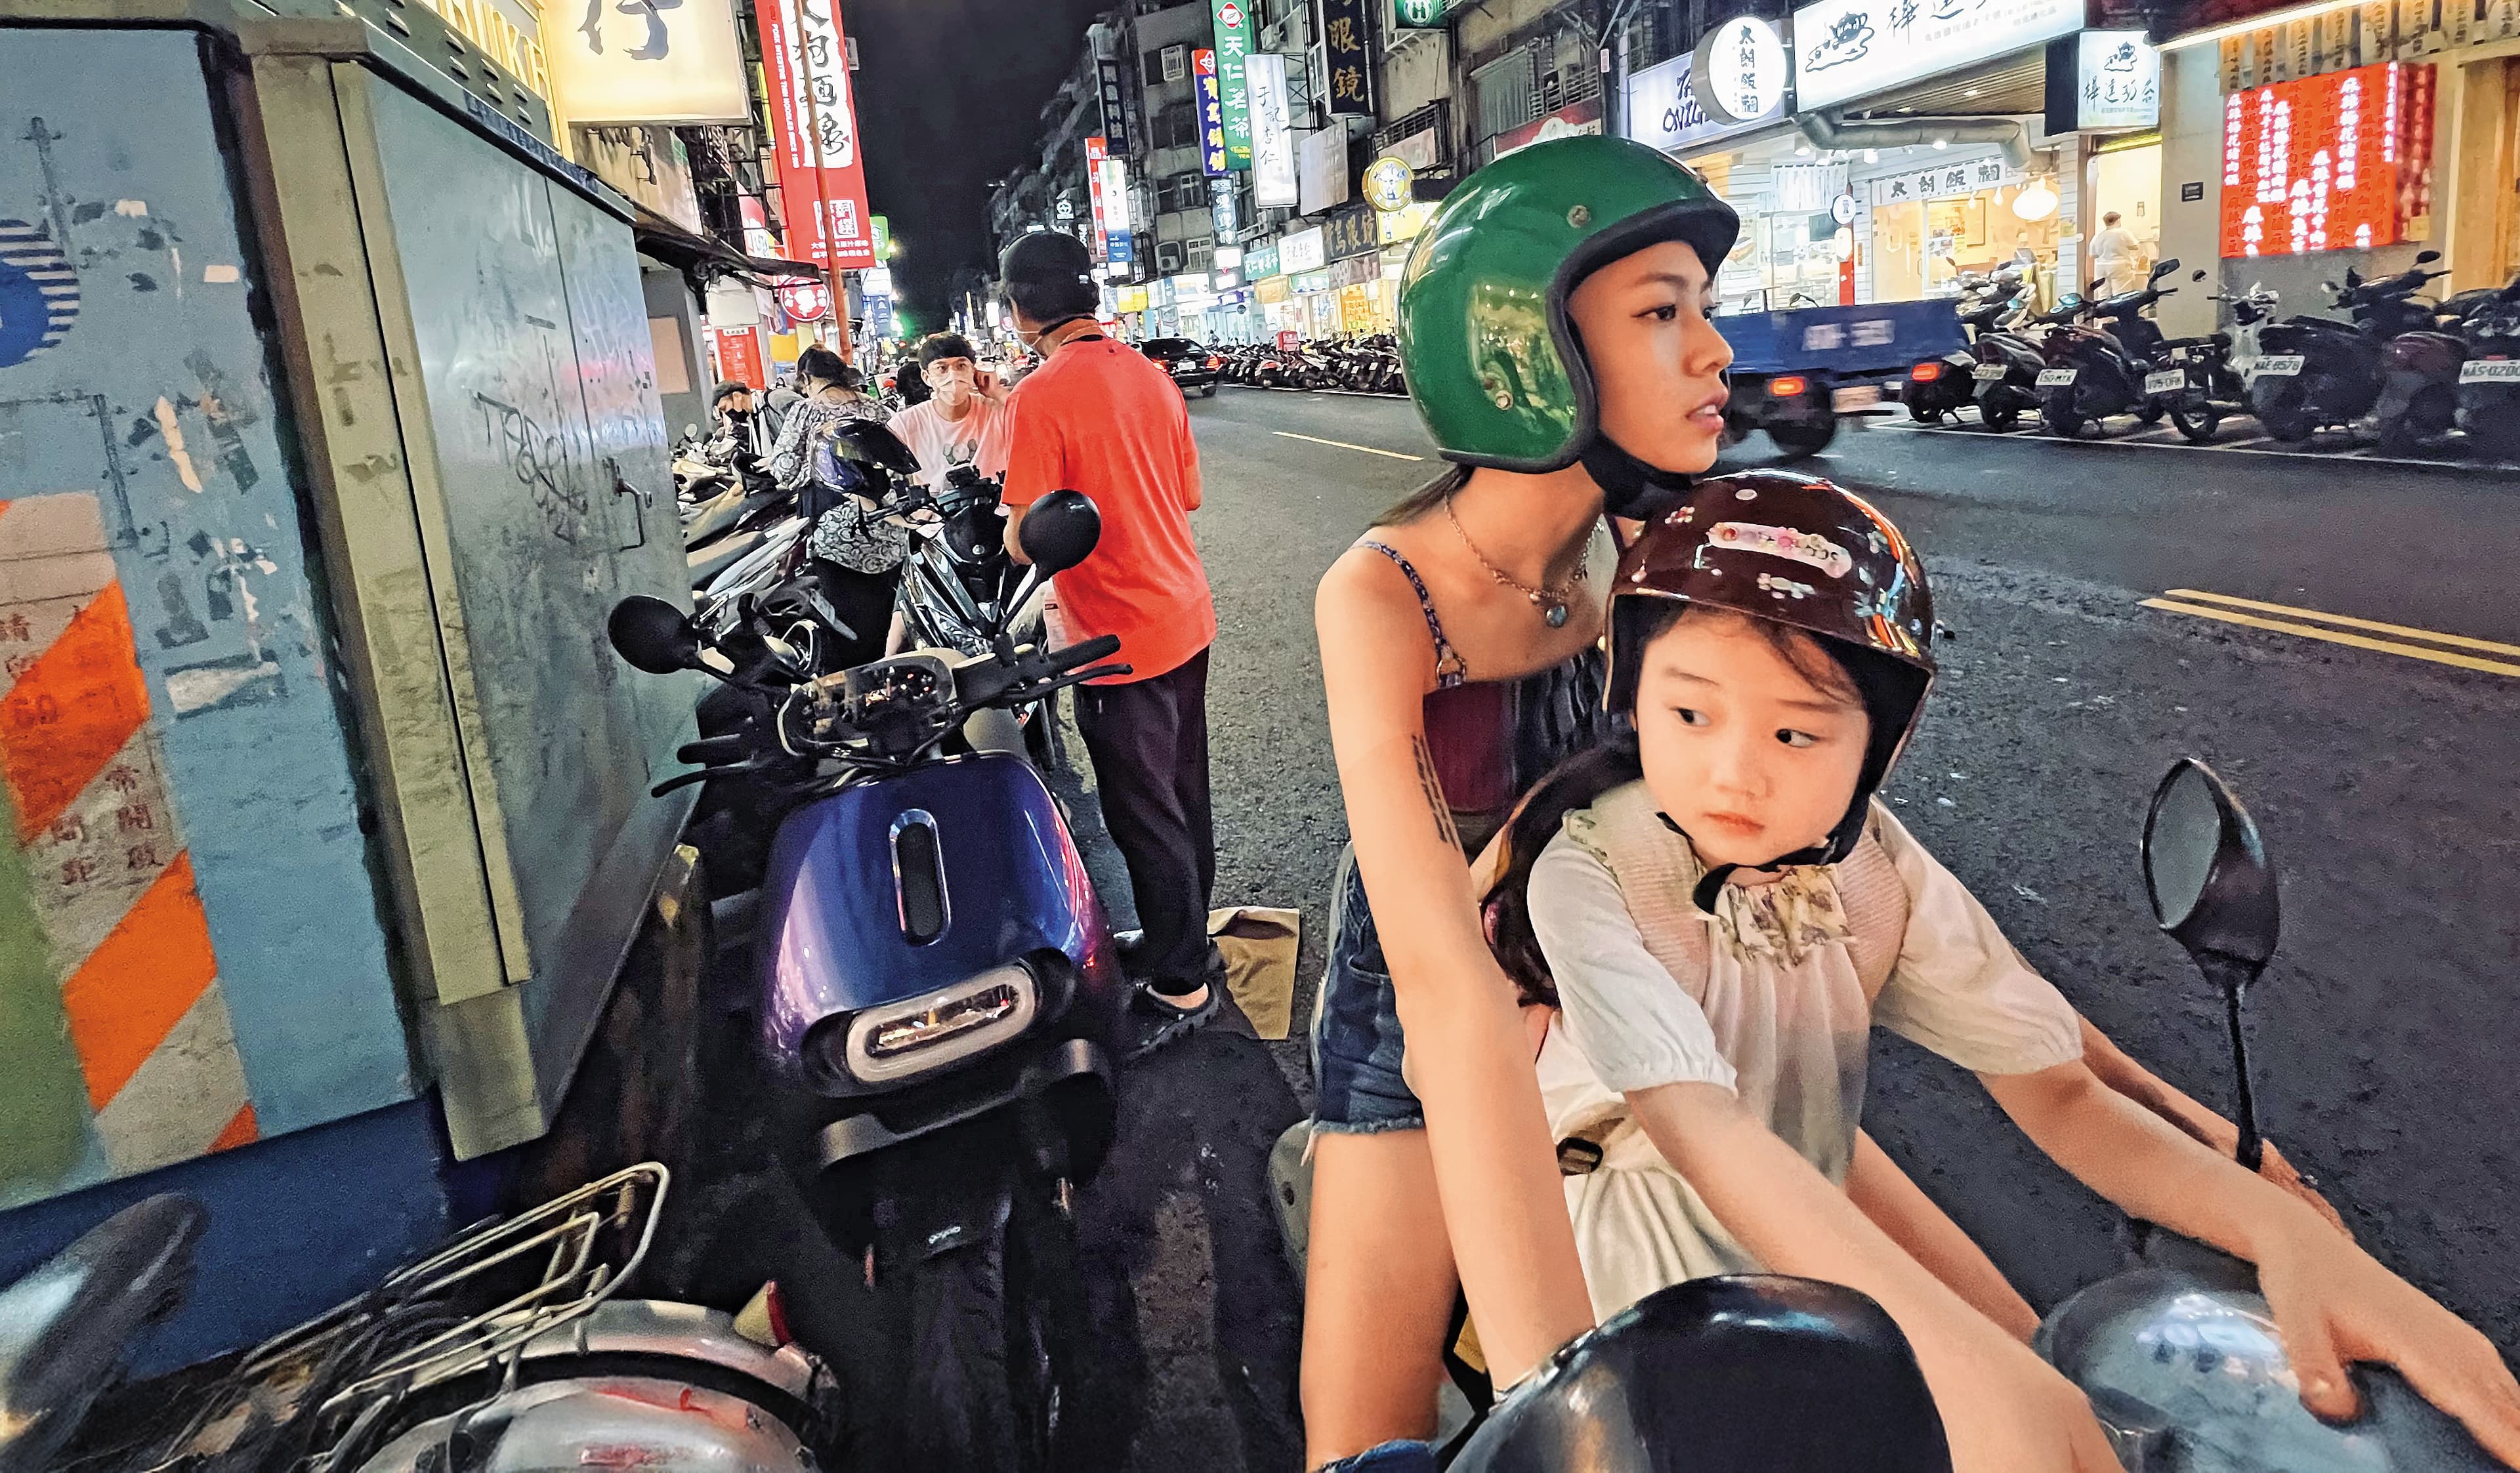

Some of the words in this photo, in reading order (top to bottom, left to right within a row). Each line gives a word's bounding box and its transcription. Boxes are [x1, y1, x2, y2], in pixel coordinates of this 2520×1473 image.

[1223, 36, 1250, 139] 天仁茗茶
[1327, 0, 1365, 102] 眼鏡
